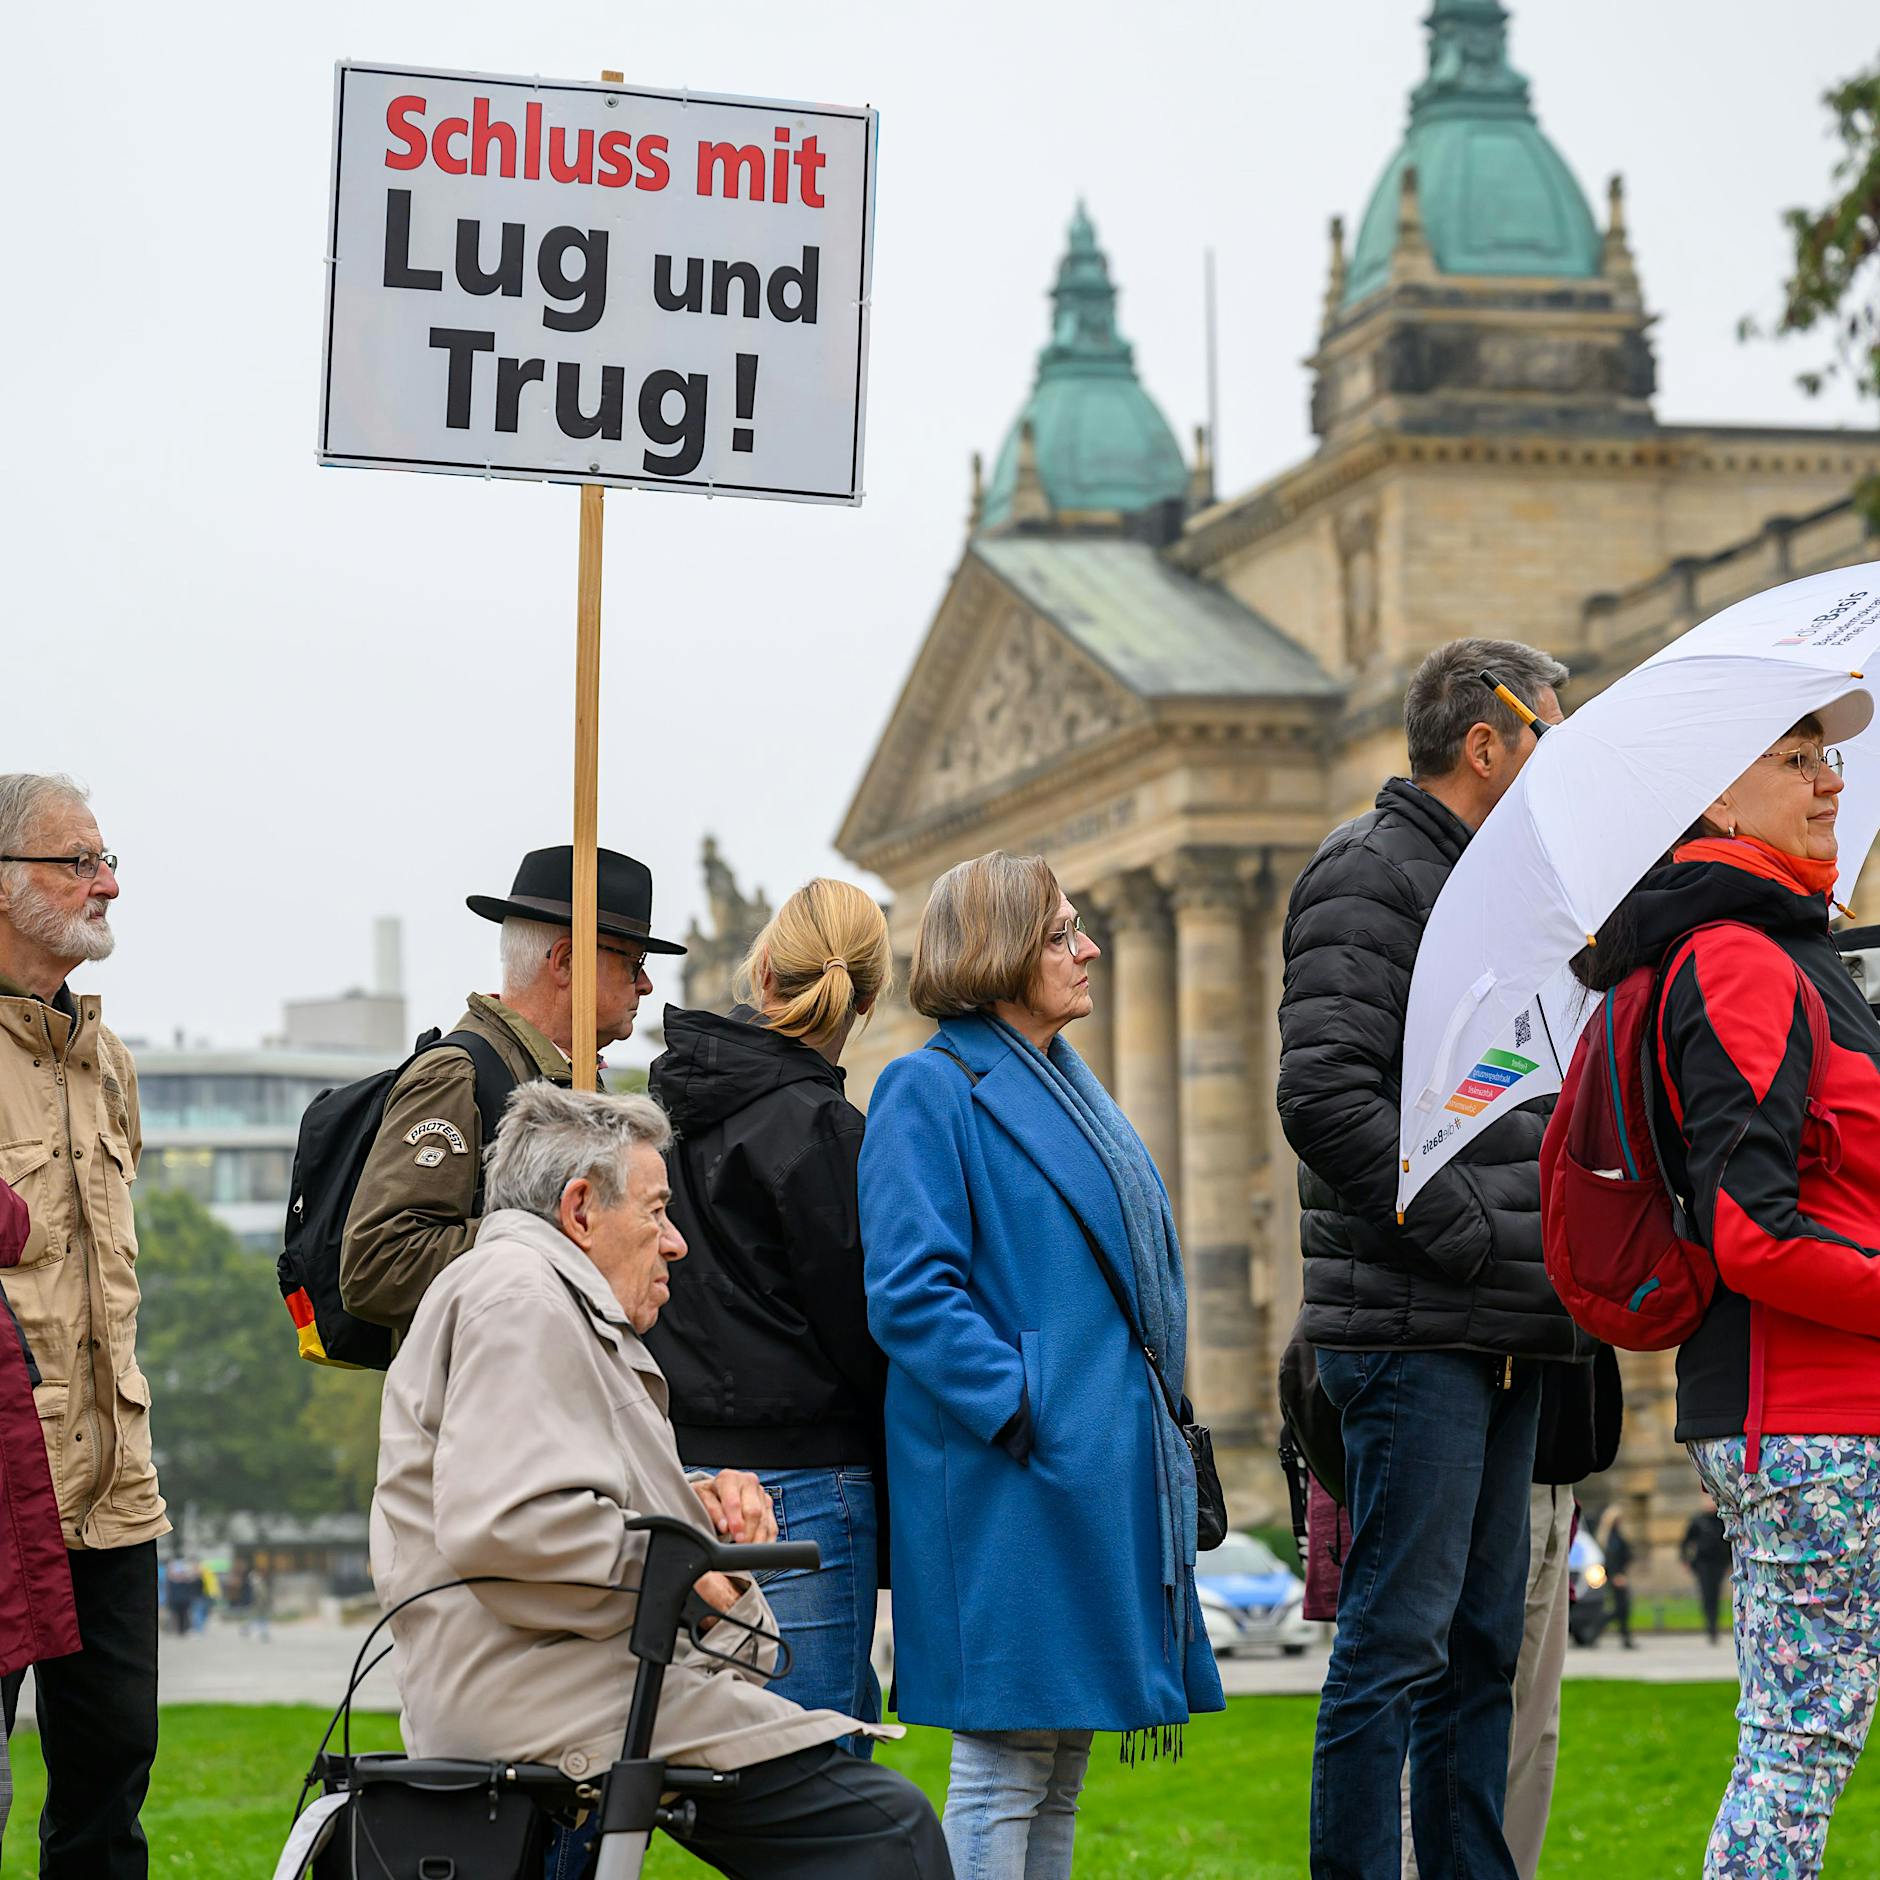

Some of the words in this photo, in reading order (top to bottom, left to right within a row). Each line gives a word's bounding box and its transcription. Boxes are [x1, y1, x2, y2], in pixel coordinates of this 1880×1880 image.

[384, 95, 670, 192] Schluss
[697, 127, 826, 208] mit
[383, 188, 609, 332] Lug
[653, 245, 820, 325] und
[429, 327, 759, 476] Trug!
[1795, 591, 1868, 637] dieBasis
[411, 1122, 463, 1149] PROTEST
